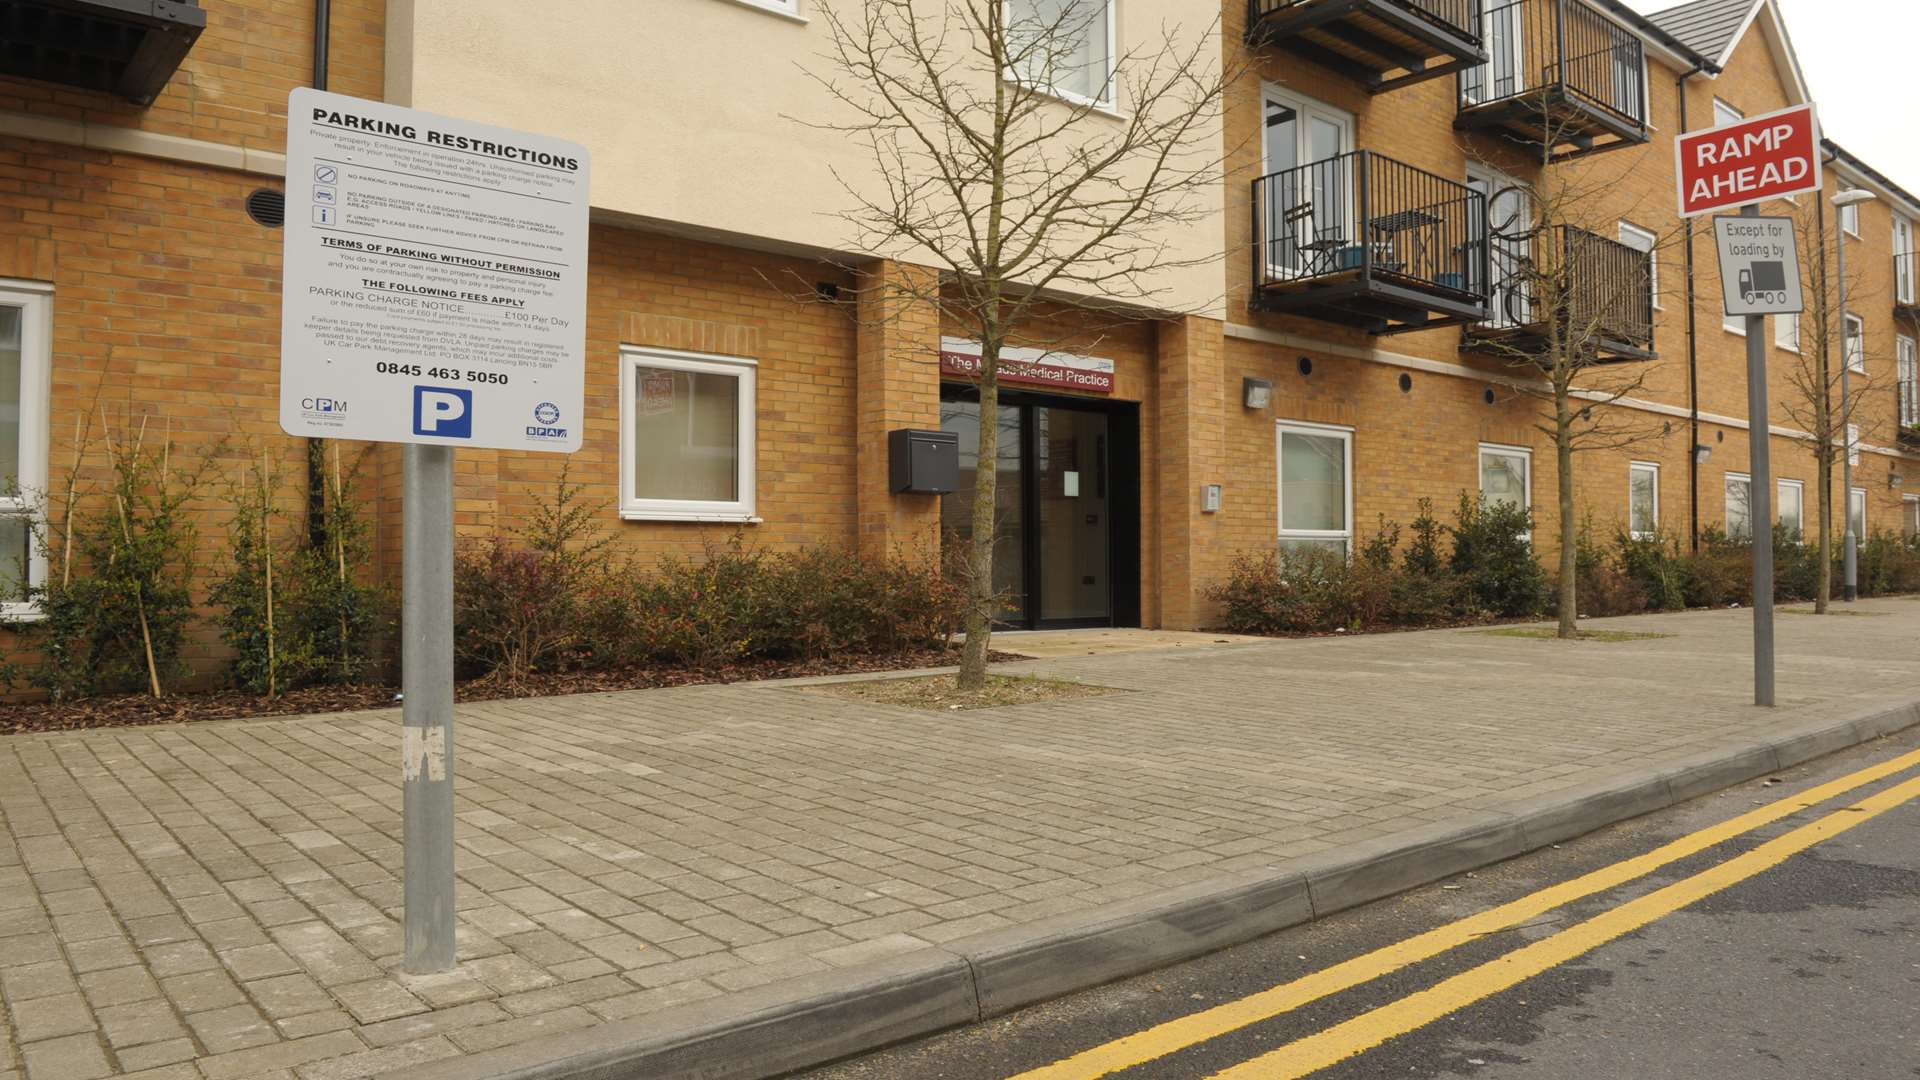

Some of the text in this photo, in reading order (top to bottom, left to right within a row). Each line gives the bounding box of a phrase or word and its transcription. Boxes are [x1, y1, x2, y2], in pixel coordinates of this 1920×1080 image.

[313, 108, 578, 170] PARKING RESTRICTIONS
[1697, 124, 1794, 168] RAMP
[309, 128, 337, 140] Private
[535, 173, 560, 183] parking
[334, 143, 355, 151] result
[384, 151, 410, 161] vehicle
[412, 156, 432, 166] being
[434, 161, 457, 169] issued
[481, 170, 507, 180] parking
[508, 175, 531, 183] charge
[358, 175, 387, 184] PARKING
[399, 182, 434, 192] ROADWAYS
[409, 162, 441, 175] following
[442, 170, 480, 181] restrictions
[1690, 156, 1808, 202] AHEAD
[358, 192, 387, 201] PARKING
[388, 197, 414, 206] OUTSIDE
[471, 211, 497, 220] PARKING
[361, 198, 387, 207] ACCESS
[415, 207, 441, 216] YELLOW
[381, 218, 405, 227] PLEASE
[1727, 224, 1783, 238] Except for
[321, 236, 560, 278] TERMS OF PARKING WITHOUT PERMISSION
[1729, 243, 1784, 258] loading by
[339, 253, 354, 261] You
[449, 270, 480, 279] property
[496, 276, 526, 284] personal
[361, 278, 524, 306] THE FOLLOWING FEES APPLY
[375, 268, 424, 279] contractually
[426, 275, 458, 284] agreeing
[489, 284, 516, 292] parking
[517, 287, 540, 295] charge
[309, 286, 364, 302] PARKING
[366, 293, 418, 311] CHARGE
[531, 314, 548, 324] Per
[550, 316, 569, 328] Day
[355, 303, 387, 311] reduced
[438, 313, 470, 322] payment
[311, 315, 338, 324] Failure
[379, 324, 407, 333] parking
[409, 327, 434, 336] charge
[315, 332, 344, 341] passed
[388, 340, 420, 348] recovery
[360, 328, 381, 338] being
[490, 344, 516, 352] parking
[373, 344, 422, 355] Management
[376, 361, 508, 384] 0845 463 5050
[948, 356, 972, 370] The
[1020, 364, 1063, 380] Medical
[1066, 370, 1109, 386] Practice
[302, 398, 347, 412] CPM
[420, 390, 464, 432] P
